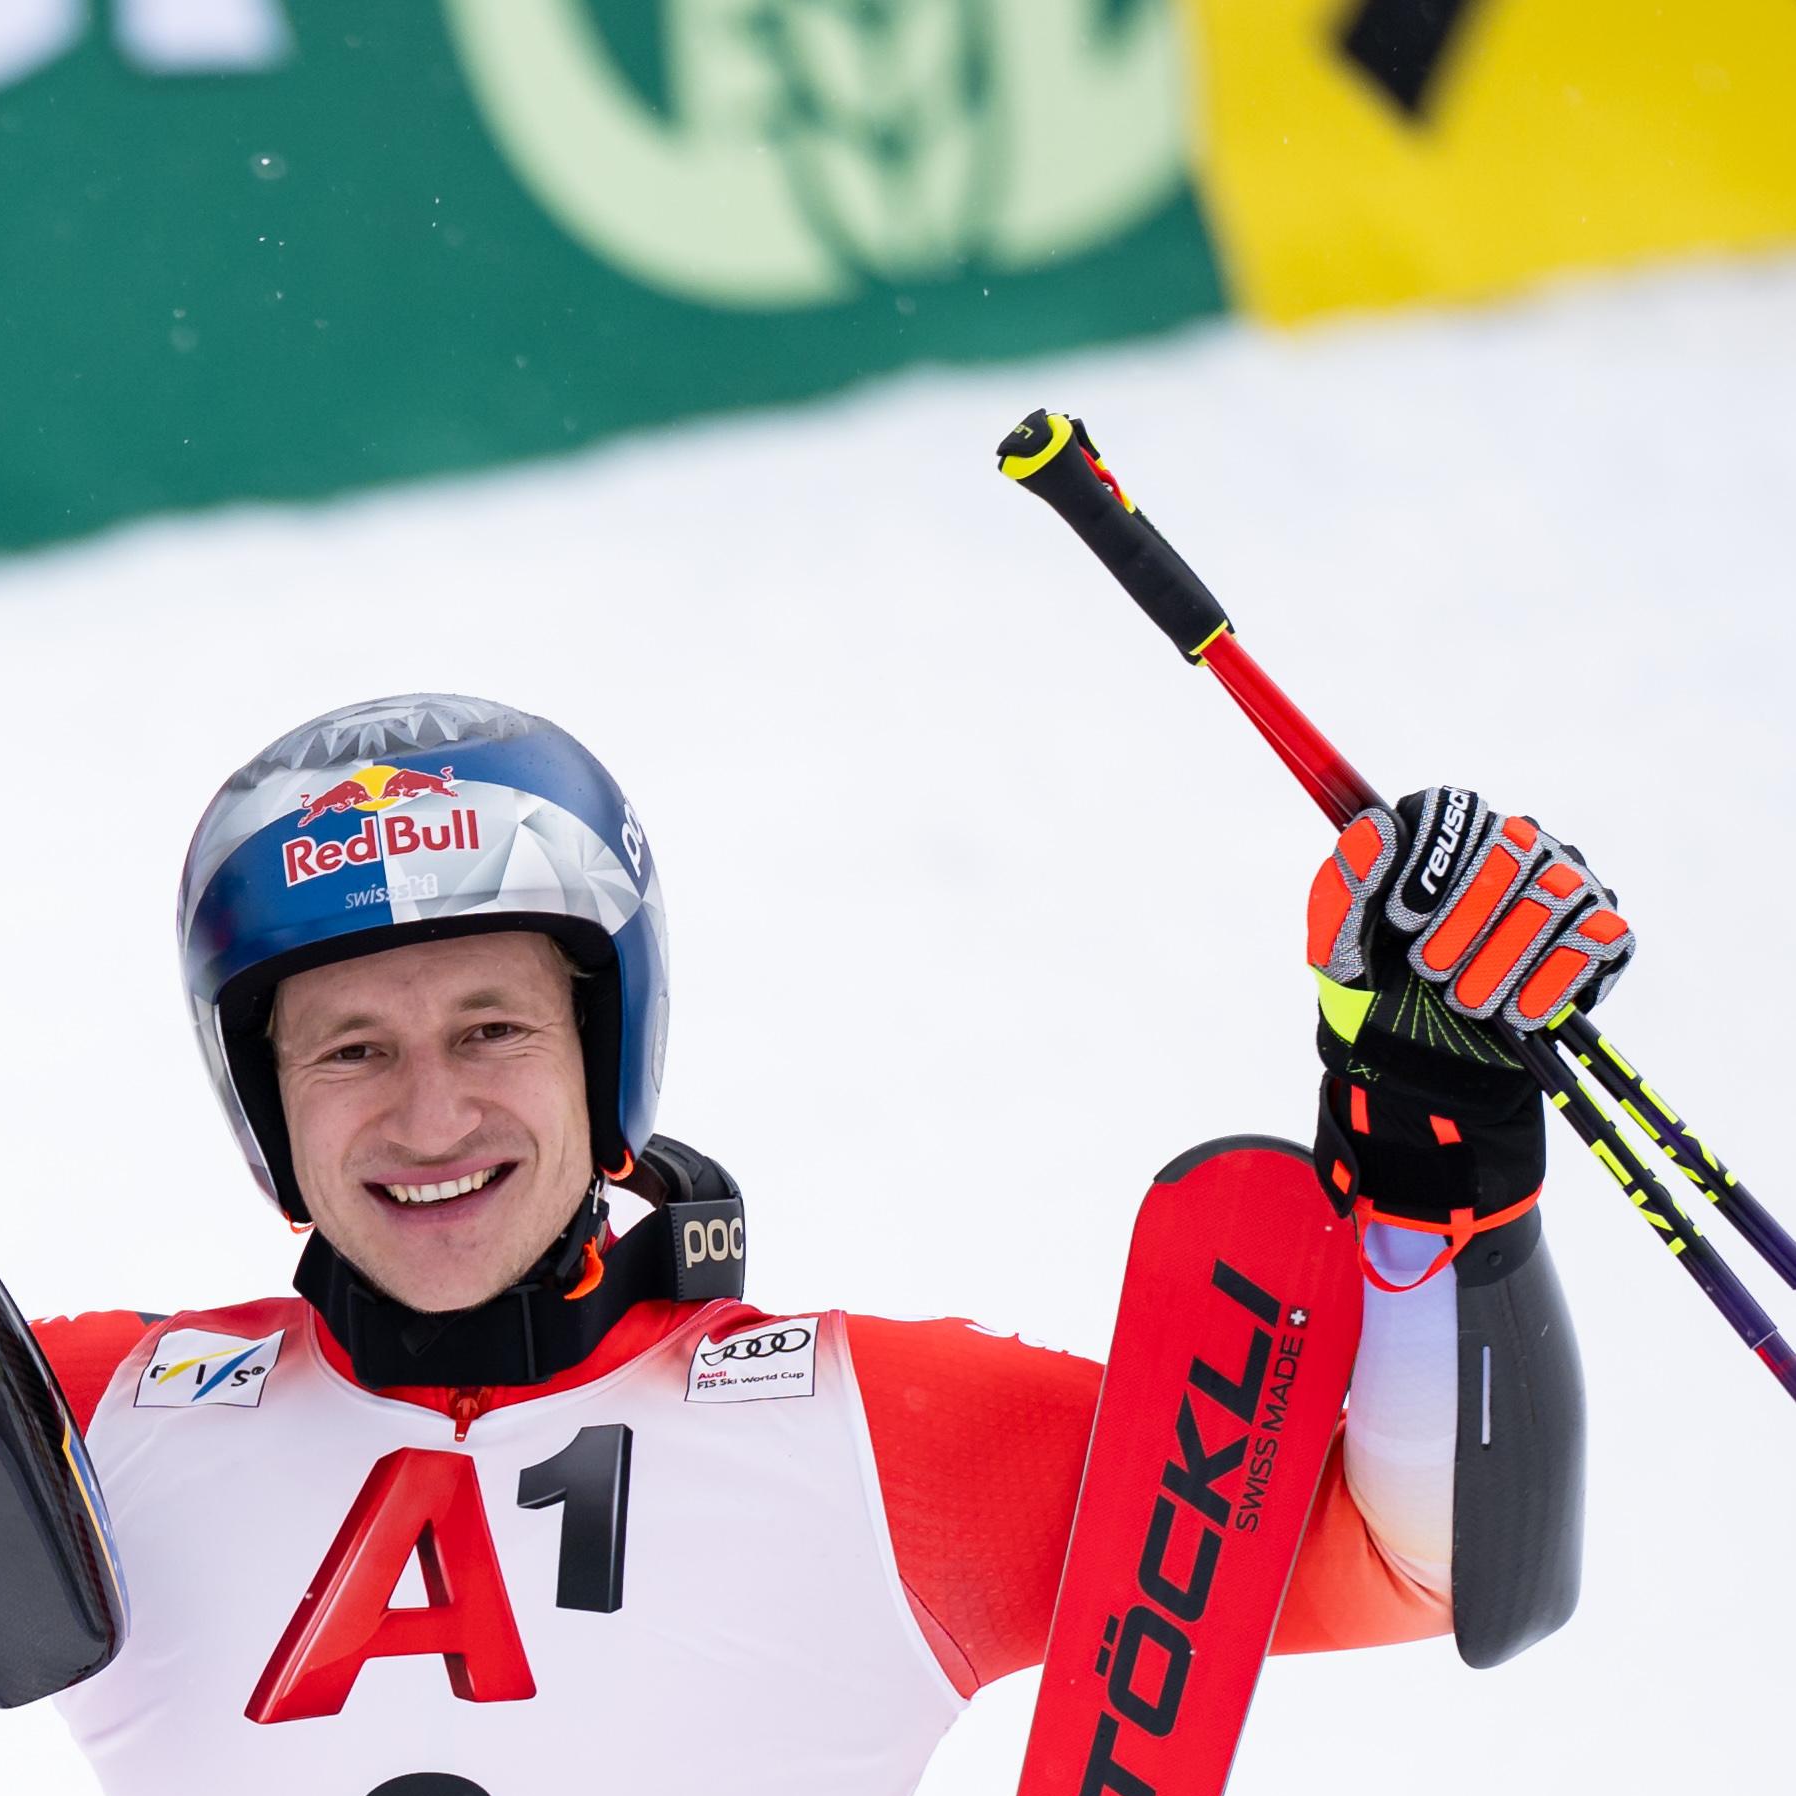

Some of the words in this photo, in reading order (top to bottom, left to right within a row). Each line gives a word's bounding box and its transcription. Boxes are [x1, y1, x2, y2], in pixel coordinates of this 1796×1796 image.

[283, 814, 381, 886] Red
[387, 809, 480, 856] Bull
[345, 874, 438, 910] swissski
[683, 1217, 743, 1268] poc
[697, 1380, 717, 1389] FIS
[719, 1378, 738, 1386] Ski
[740, 1373, 778, 1384] World
[781, 1371, 805, 1380] Cup
[698, 1370, 727, 1380] Audi
[1235, 1437, 1279, 1533] SWISS
[1260, 1336, 1305, 1434] MADE
[244, 1423, 633, 1724] A1
